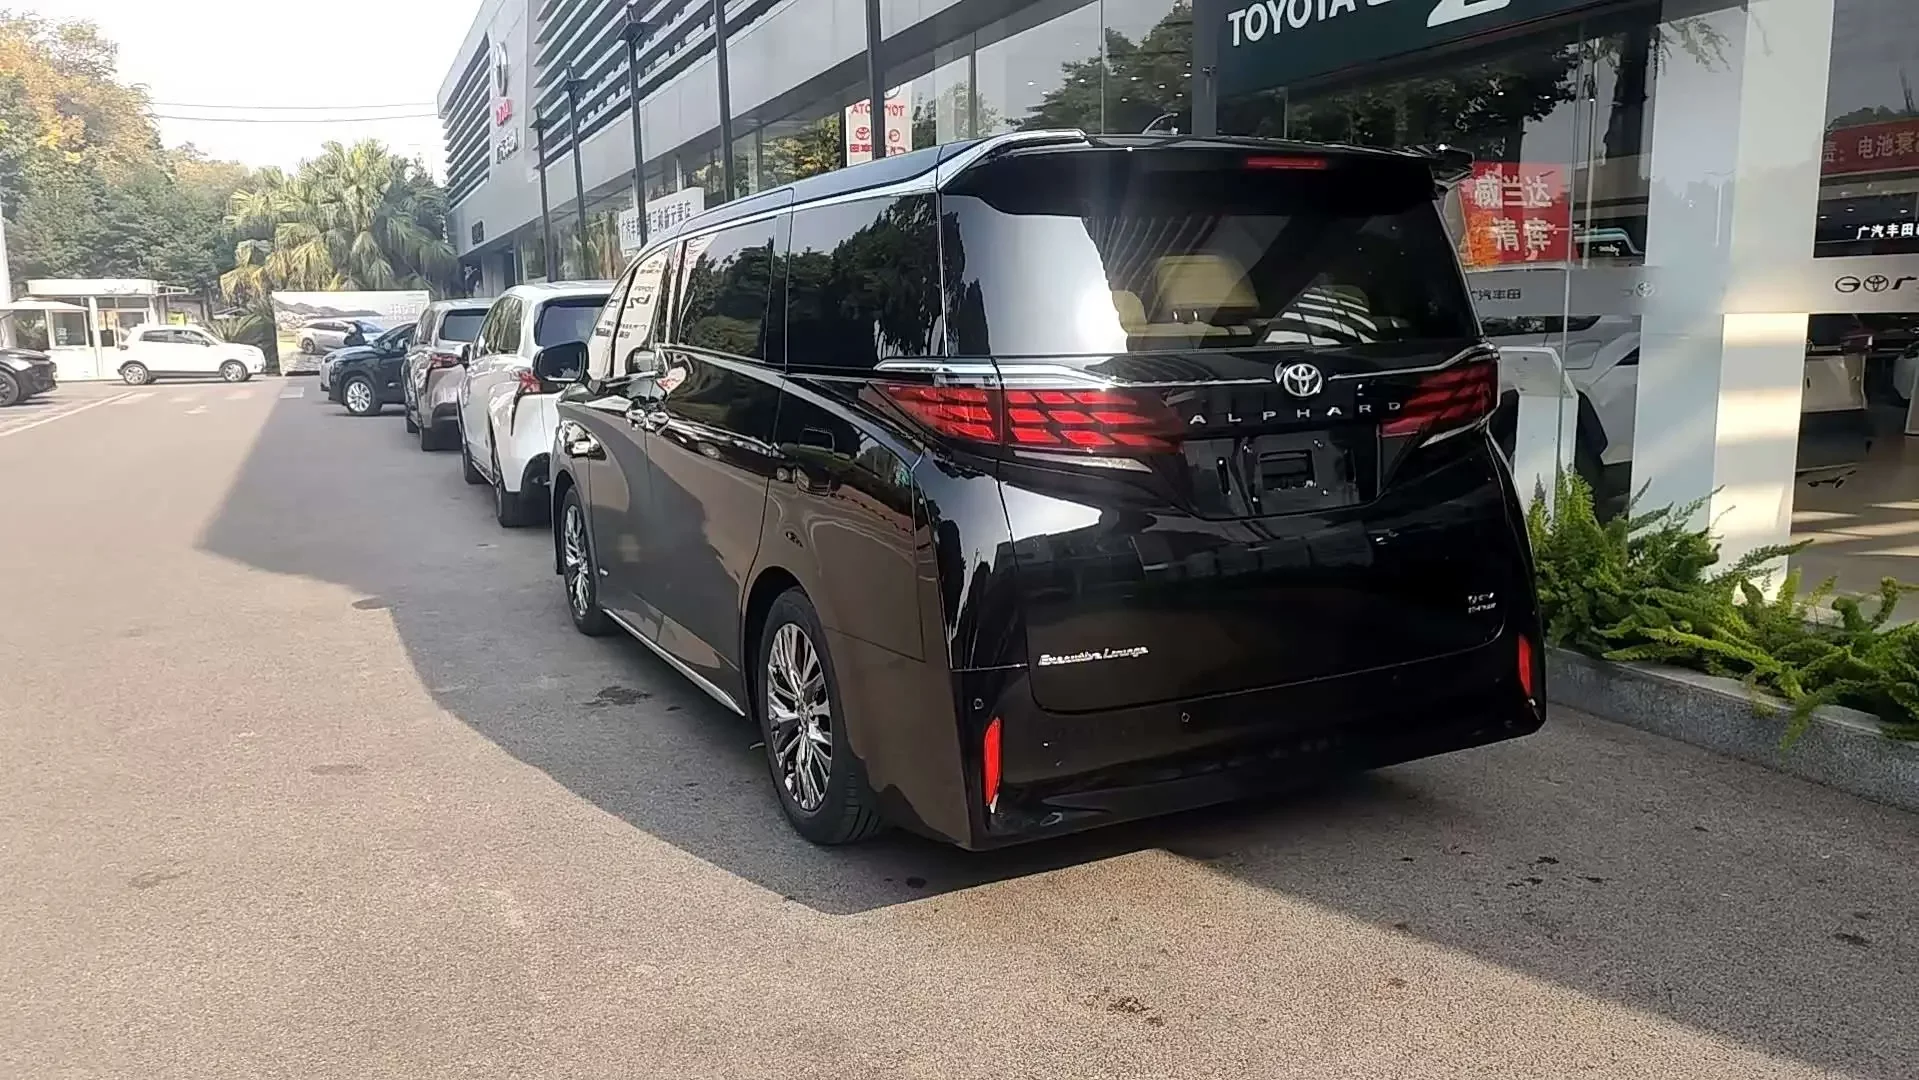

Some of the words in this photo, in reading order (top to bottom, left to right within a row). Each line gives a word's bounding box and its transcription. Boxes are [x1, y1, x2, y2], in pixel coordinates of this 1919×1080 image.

[1475, 171, 1552, 208] 威兰达
[1857, 222, 1919, 240] 广汽丰田
[1190, 402, 1401, 425] ALPHARD
[1038, 651, 1103, 666] Executive
[1103, 646, 1149, 659] Lounge
